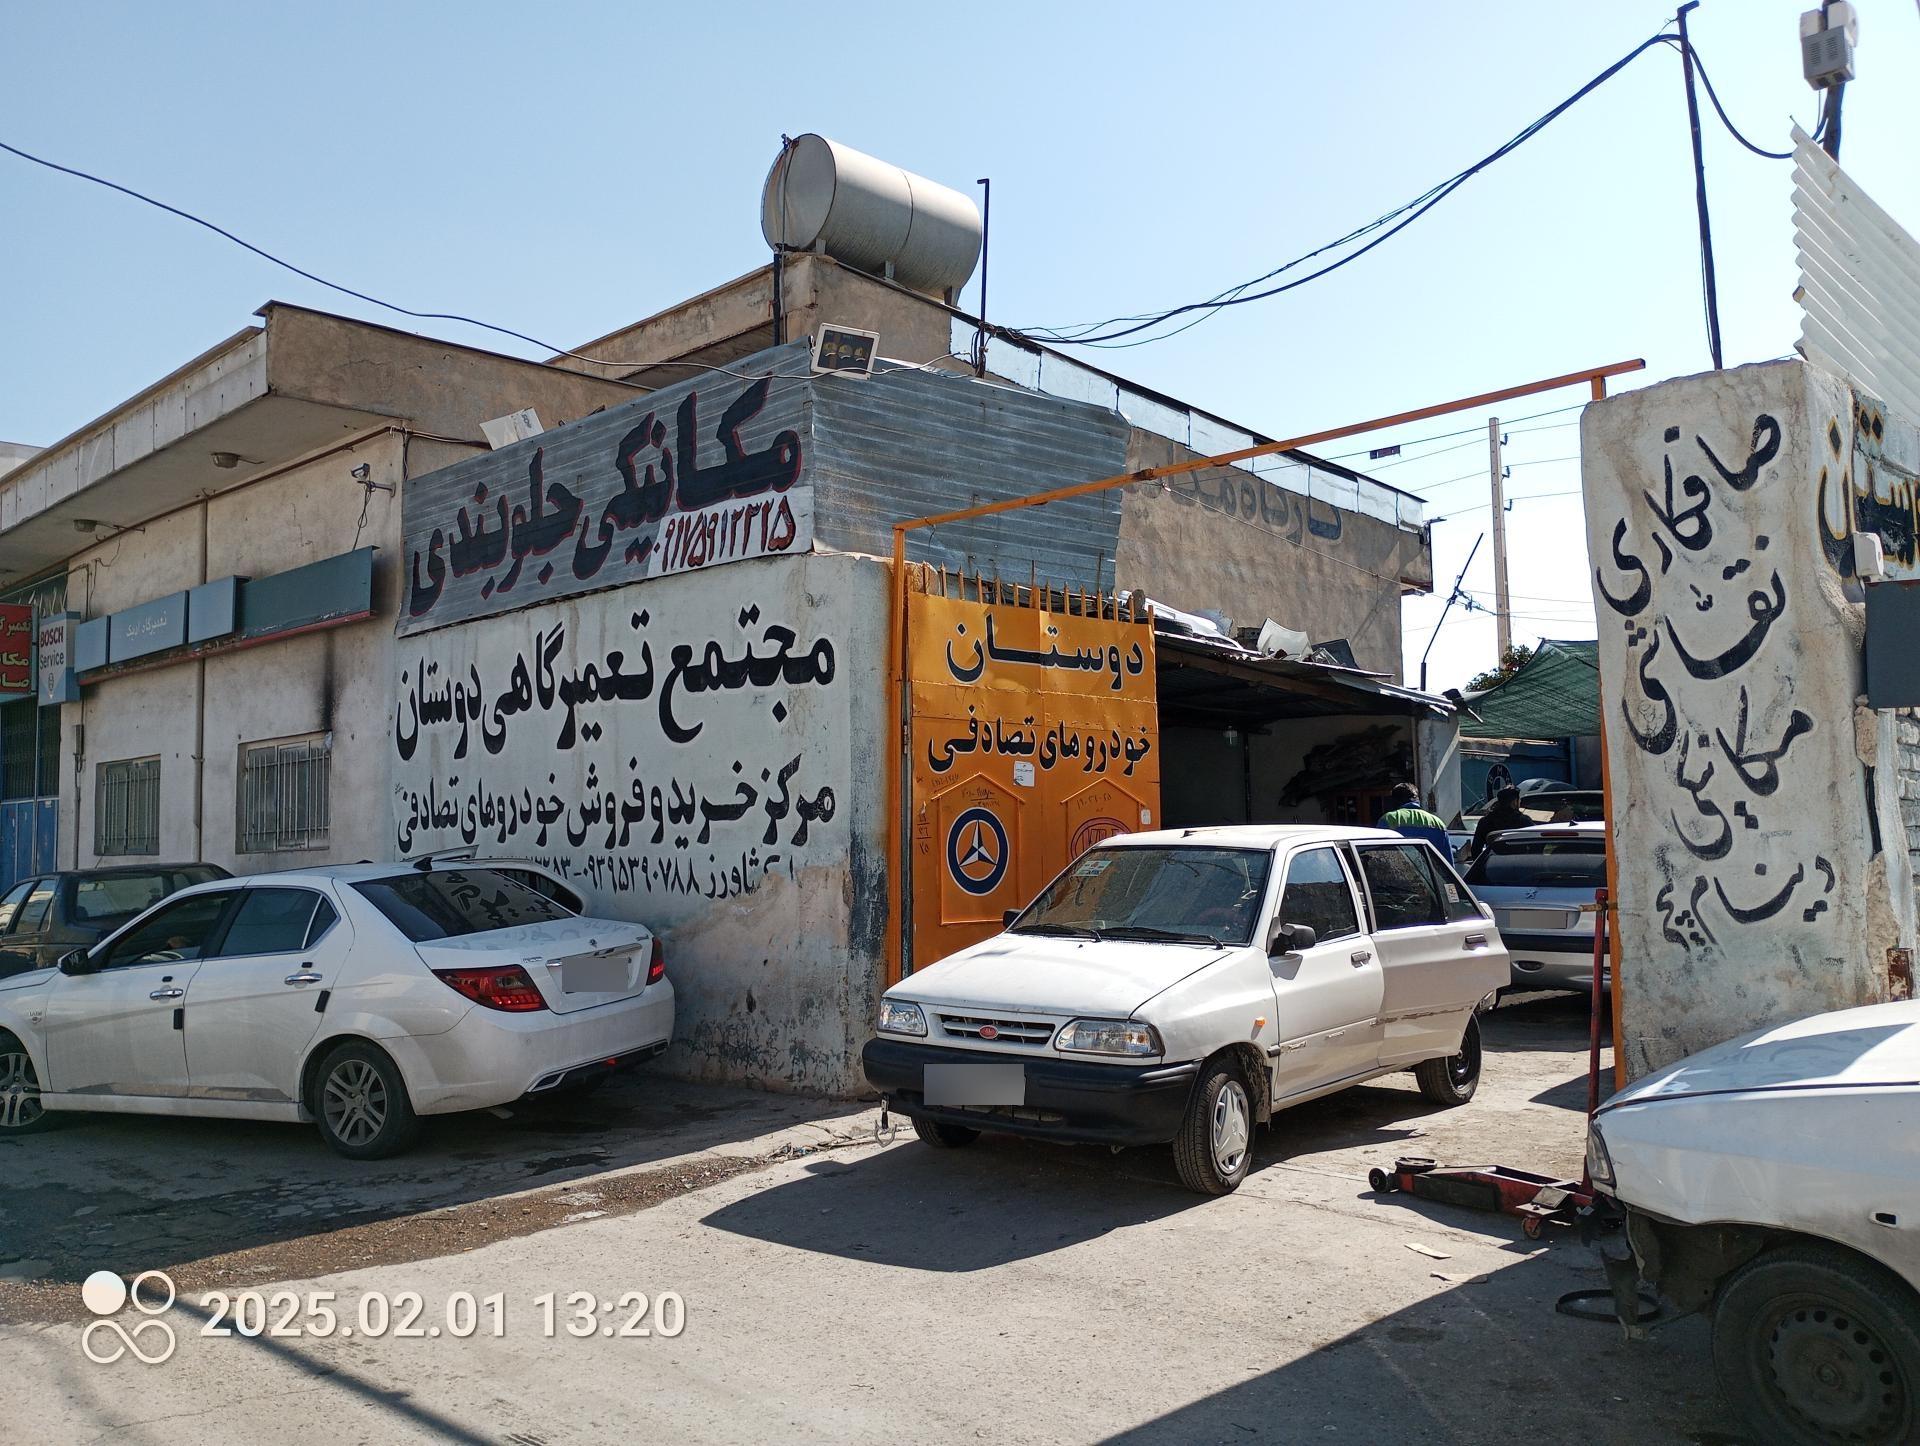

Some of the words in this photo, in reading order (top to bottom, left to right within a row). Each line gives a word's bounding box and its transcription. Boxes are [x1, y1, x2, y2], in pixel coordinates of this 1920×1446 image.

[409, 447, 583, 616] جلوبندی
[40, 625, 64, 648] BOSCH
[40, 650, 65, 670] Service
[659, 603, 835, 744] مجتمع
[946, 613, 1144, 690] دوستان
[396, 655, 482, 760] دوستان
[927, 704, 1037, 774] تصادفی
[1039, 720, 1151, 776] خودروهای
[762, 754, 836, 847] مرکز
